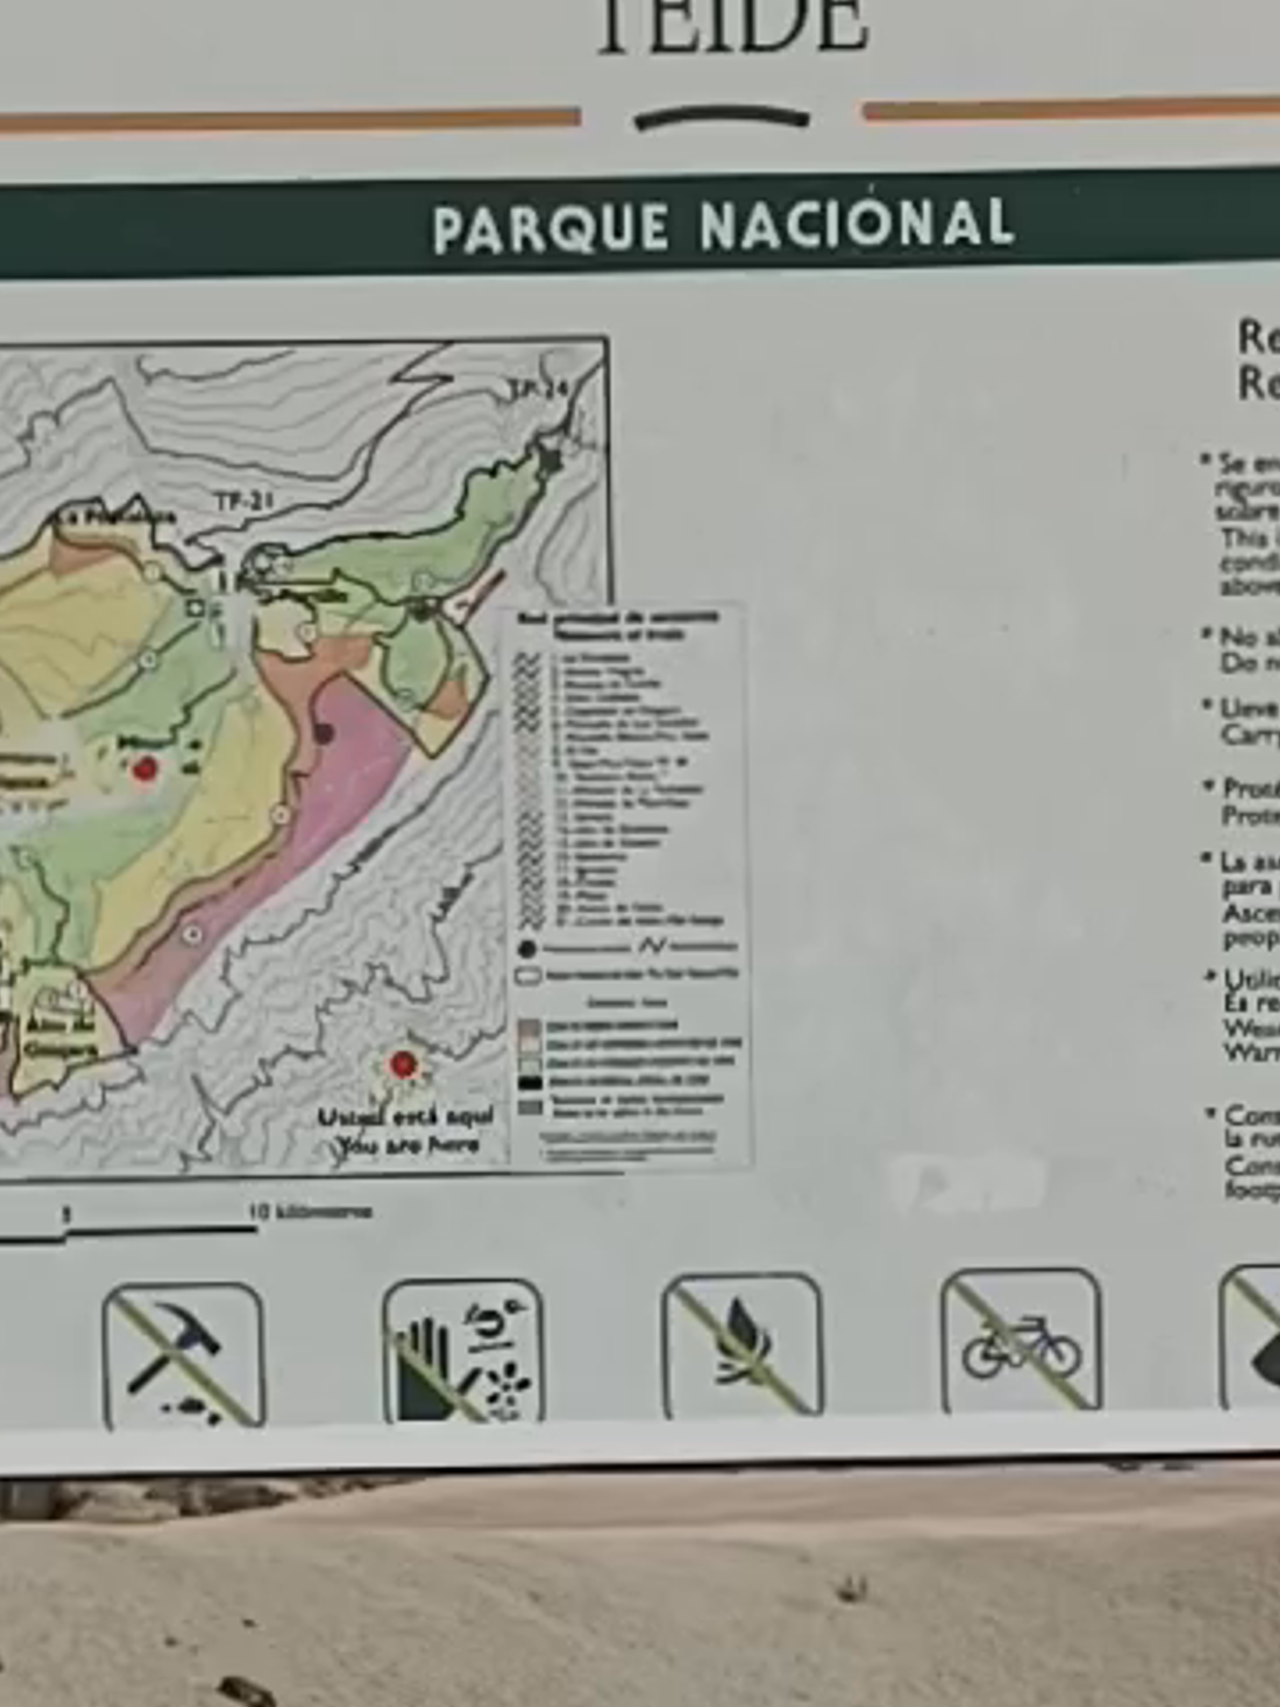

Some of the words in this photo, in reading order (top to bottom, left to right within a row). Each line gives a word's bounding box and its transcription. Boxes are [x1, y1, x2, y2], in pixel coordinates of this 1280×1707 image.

[433, 202, 669, 255] PARQUE
[701, 197, 1016, 251] NACIONAL
[1221, 625, 1257, 647] No
[1221, 651, 1258, 673] Do
[1221, 851, 1246, 872] La
[1222, 878, 1272, 899] para
[1224, 1127, 1243, 1148] la
